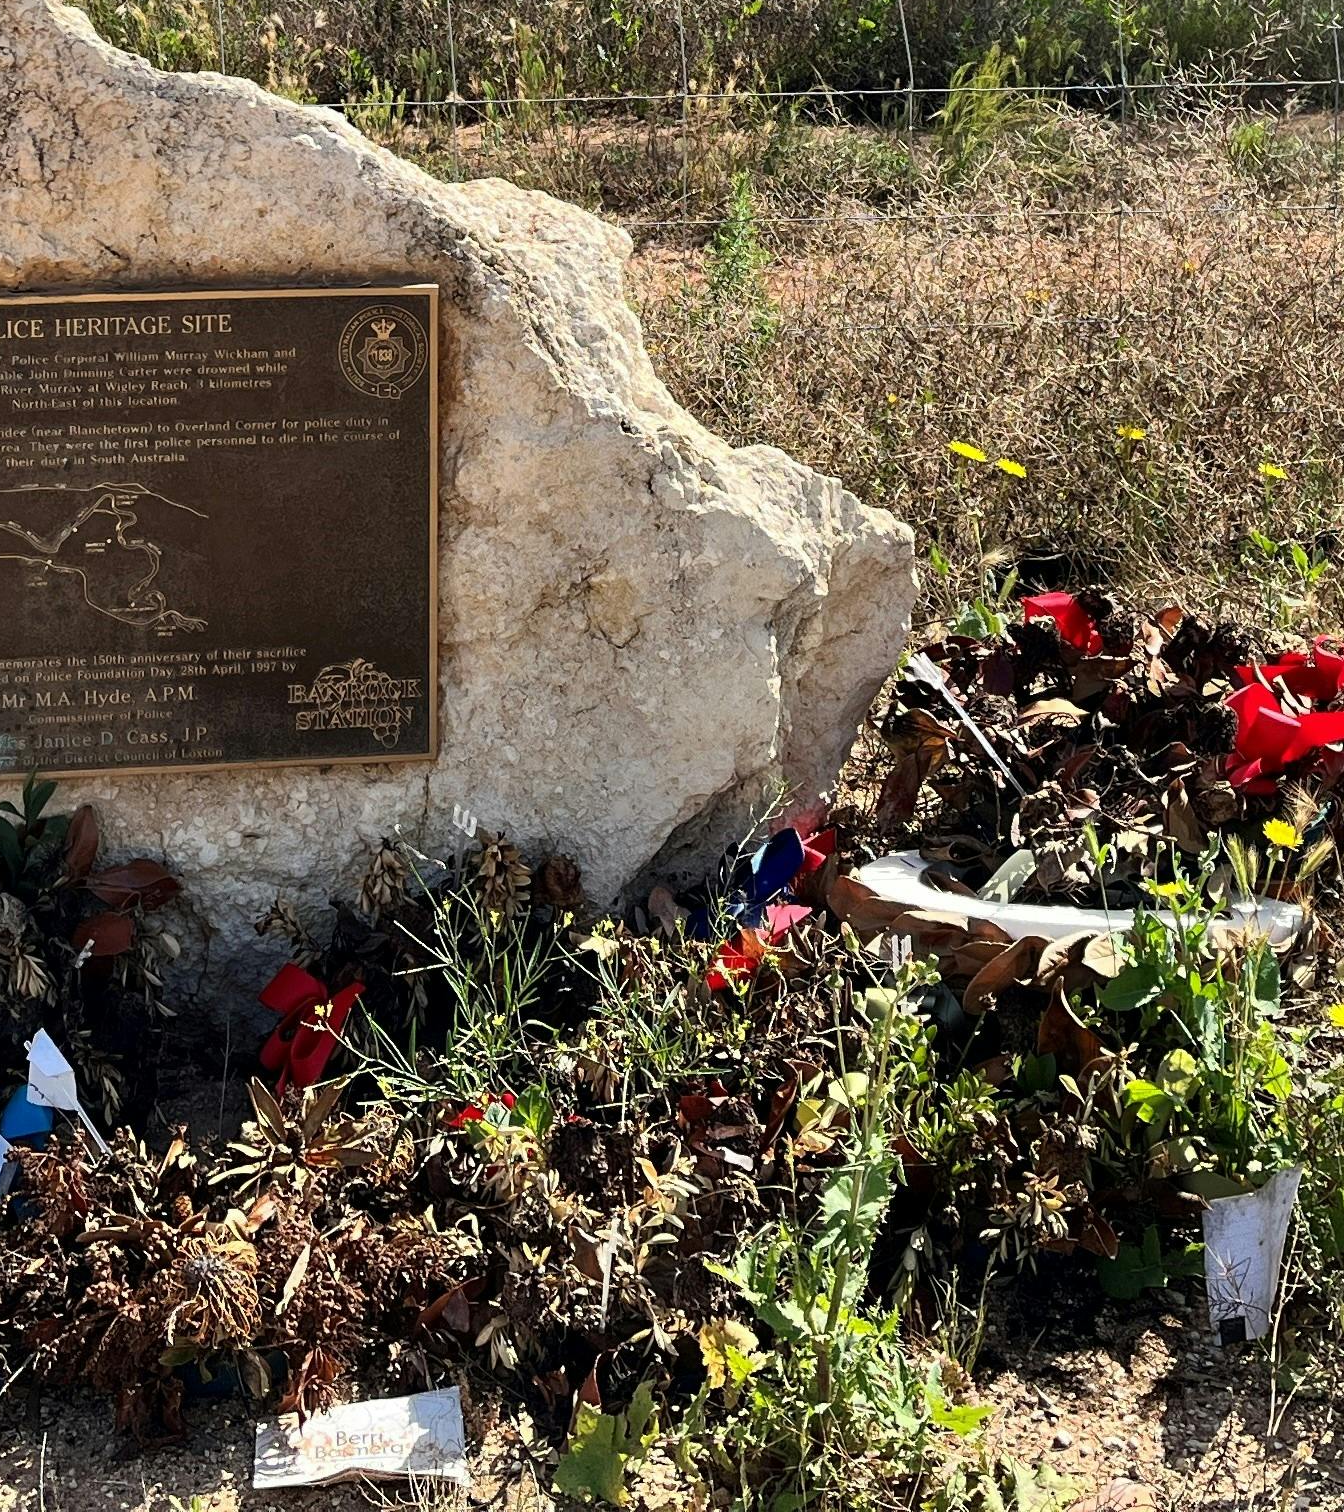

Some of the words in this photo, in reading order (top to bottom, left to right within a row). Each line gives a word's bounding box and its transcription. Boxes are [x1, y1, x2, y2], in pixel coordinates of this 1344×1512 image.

[56, 316, 172, 337] HERITAGE
[181, 314, 233, 334] SITE
[11, 355, 49, 366] Police
[54, 353, 109, 366] Corporal
[115, 351, 159, 362] William
[165, 350, 208, 364] Murray
[214, 348, 269, 360] Wickham
[274, 347, 297, 358] and
[28, 369, 58, 380] John
[63, 367, 115, 380] Dunning
[119, 367, 157, 377] Carter
[163, 367, 193, 376] were
[197, 364, 250, 375] drowned
[256, 362, 288, 374] while
[0, 385, 33, 395] River
[39, 384, 82, 396] Murray
[88, 383, 99, 393] at
[106, 380, 145, 393] Wigley
[209, 378, 272, 389] kilometres
[83, 397, 95, 408] of
[99, 397, 122, 407] this
[31, 425, 63, 439] (near
[69, 421, 154, 438] Blanchetown)
[157, 423, 170, 433] to
[174, 421, 231, 433] Overland
[235, 420, 277, 431] Corner
[282, 418, 298, 430] for
[304, 418, 340, 431] police
[345, 417, 372, 429] duty
[378, 416, 389, 426] in
[29, 441, 59, 454] They
[65, 441, 94, 450] were
[99, 439, 120, 449] the
[124, 438, 149, 449] first
[155, 437, 192, 450] police
[196, 435, 257, 449] personnel
[261, 435, 274, 445] to
[279, 433, 298, 444] die
[302, 433, 314, 443] in
[319, 432, 339, 442] the
[343, 431, 384, 442] course
[388, 430, 400, 440] of
[5, 457, 35, 468] their
[40, 456, 69, 468] duty
[73, 455, 85, 465] in
[90, 454, 125, 465] South
[67, 657, 87, 667] the
[93, 655, 125, 666] 150th
[130, 653, 201, 666] anniversary
[206, 650, 219, 661] of
[224, 649, 252, 660] their
[256, 647, 307, 659] sacrifice
[14, 674, 30, 683] on
[35, 671, 72, 682] Police
[77, 667, 145, 681] Foundation
[180, 666, 207, 677] 28th
[250, 662, 277, 673] 1997
[282, 661, 297, 674] by
[2, 693, 27, 709] Mr
[35, 691, 75, 708] M.A.
[144, 686, 198, 703] A.P.M.
[287, 678, 423, 704] BANROCK
[28, 712, 114, 725] Commissioner
[119, 710, 132, 721] of
[136, 709, 173, 720] Police
[296, 706, 414, 731] STATION
[35, 733, 92, 750] Janice
[23, 755, 34, 766] of
[39, 755, 58, 765] the
[64, 752, 109, 764] District
[114, 749, 159, 762] Council
[164, 748, 177, 759] of
[181, 746, 224, 760] Loxton
[336, 1431, 384, 1447] Berri
